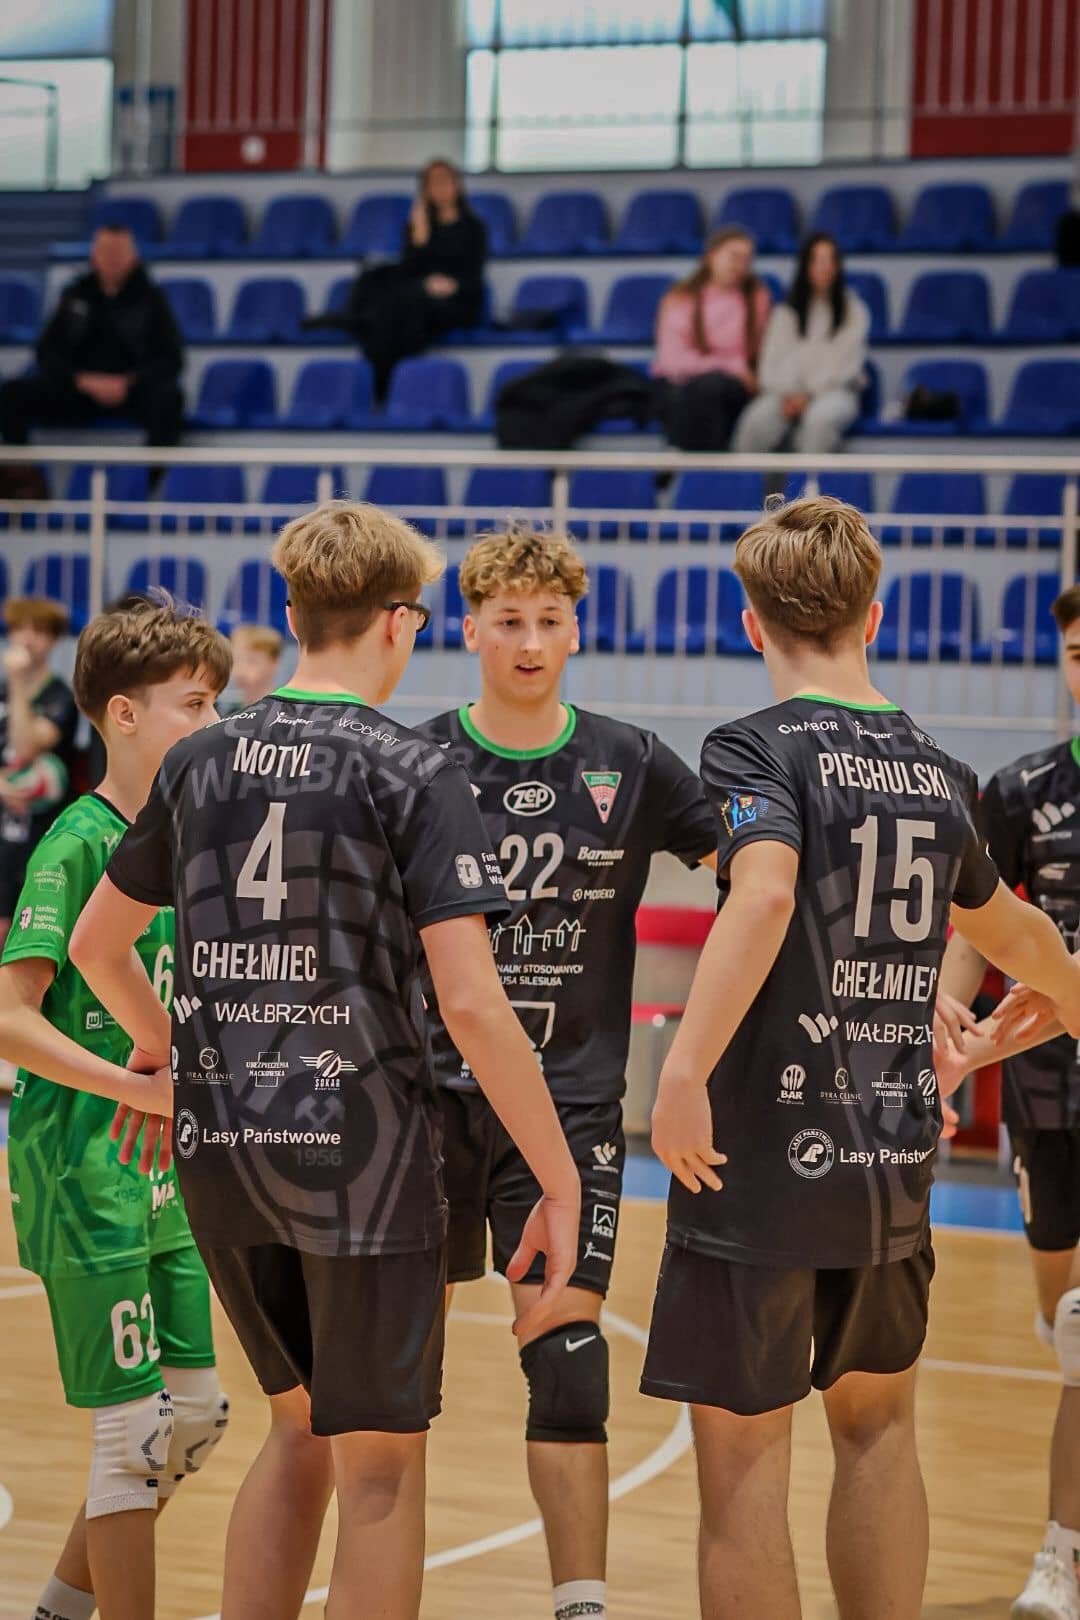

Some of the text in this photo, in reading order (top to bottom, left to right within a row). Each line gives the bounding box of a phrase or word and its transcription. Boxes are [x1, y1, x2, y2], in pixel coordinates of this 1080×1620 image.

[338, 716, 401, 747] WOBART
[232, 736, 312, 778] MOTYL
[818, 752, 951, 800] PIECHULSKI
[236, 802, 288, 921] 4
[500, 832, 565, 901] 22
[850, 814, 936, 943] 15
[152, 944, 174, 1010] 6
[192, 941, 317, 982] CHEŁMIEC
[215, 1002, 350, 1025] WAŁBRZYCH
[781, 1090, 803, 1100] BAR
[203, 1128, 341, 1148] Lasy Państwowe
[840, 1147, 875, 1168] Lasy
